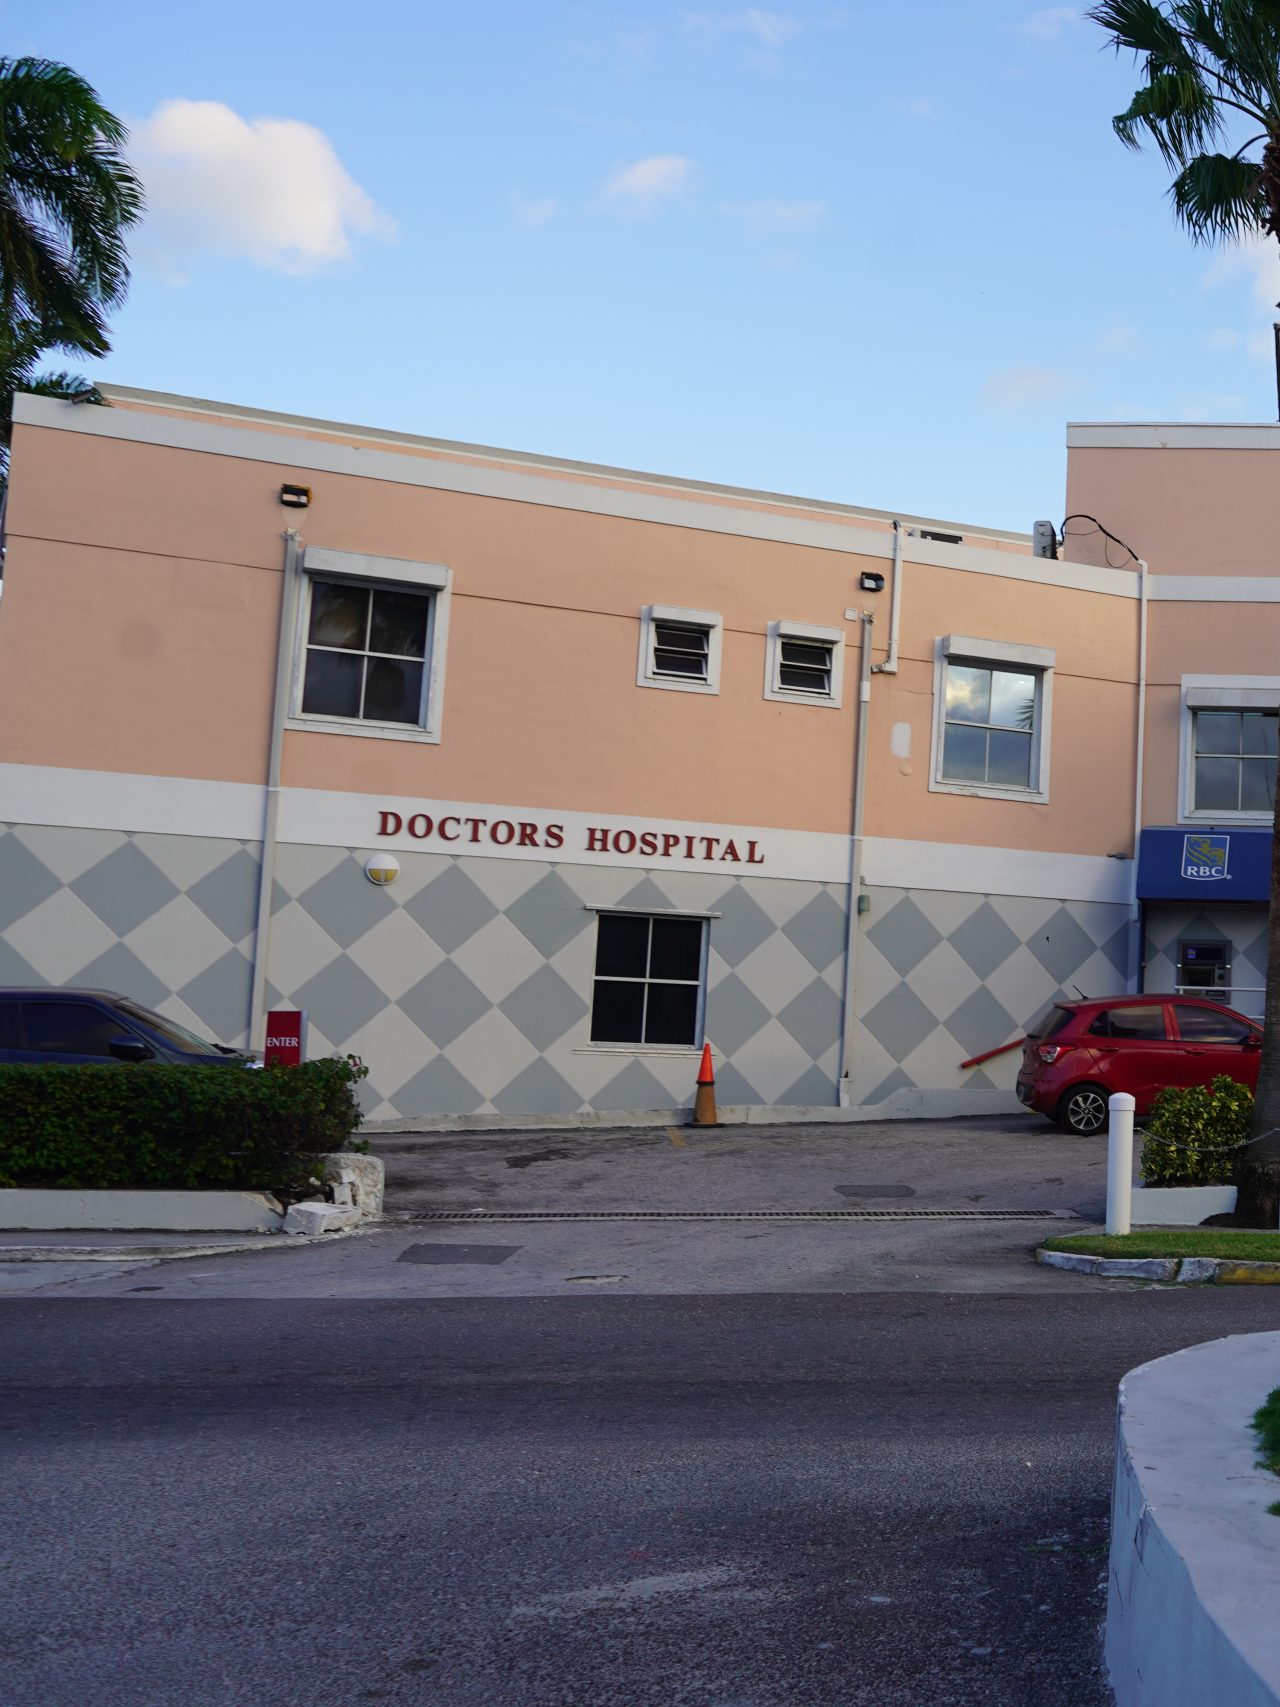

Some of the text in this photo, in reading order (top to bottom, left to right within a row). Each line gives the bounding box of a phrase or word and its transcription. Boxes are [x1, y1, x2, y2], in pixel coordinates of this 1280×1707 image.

[377, 811, 765, 863] DOCTORS HOSPITAL
[1187, 866, 1224, 877] RBC
[267, 1037, 299, 1047] ENTER
